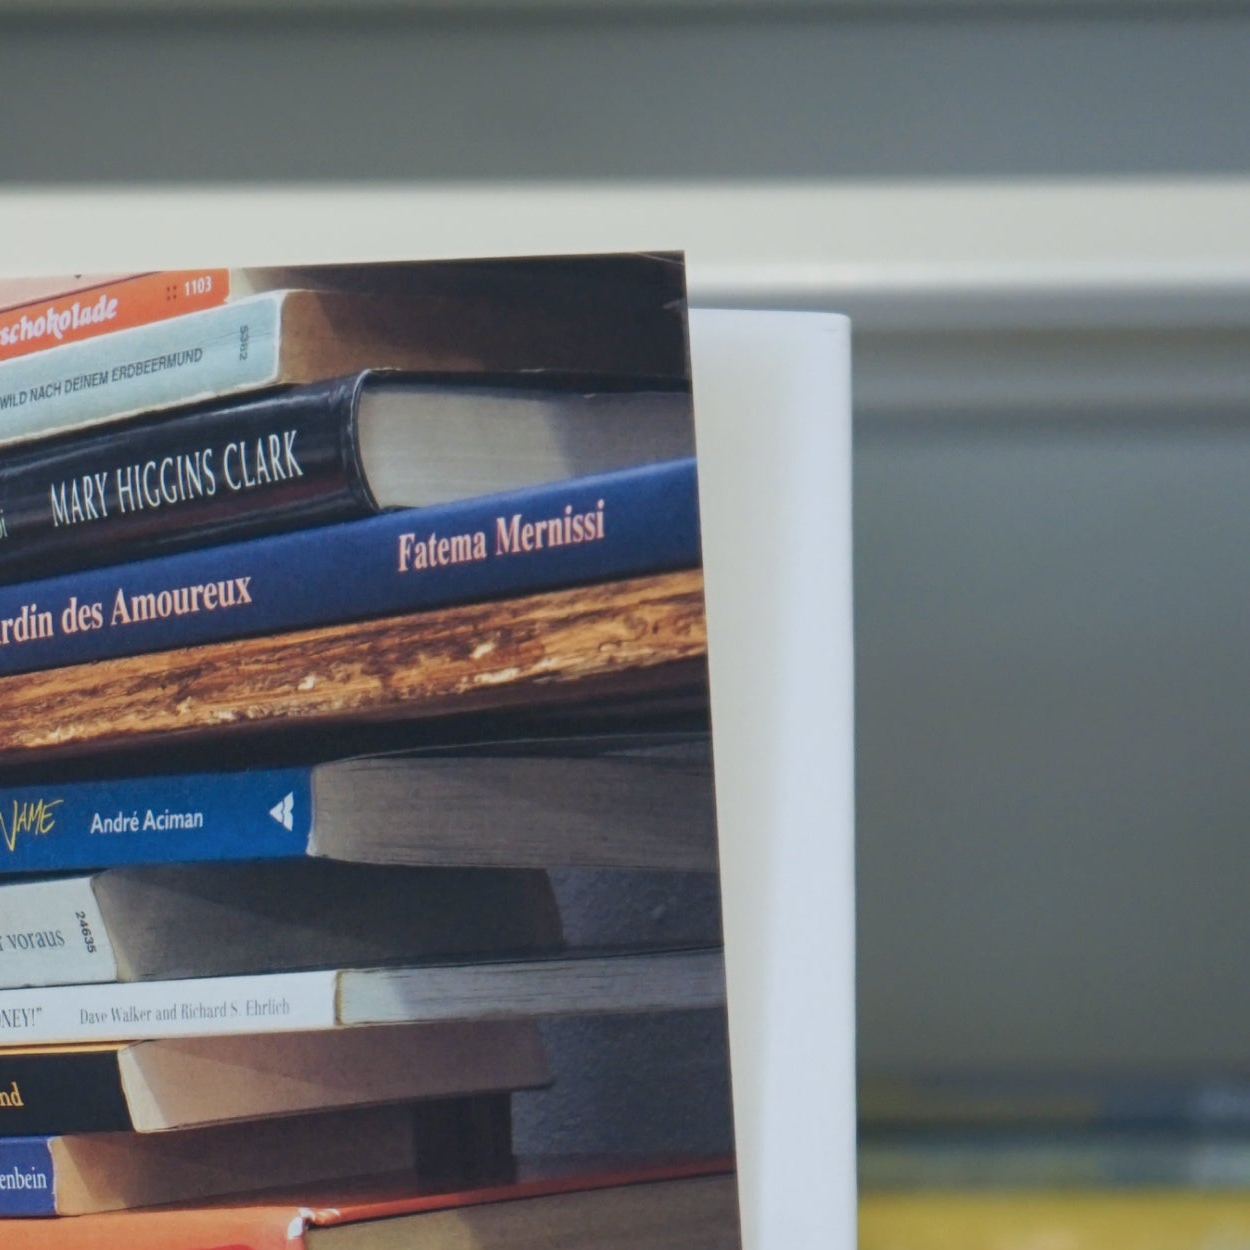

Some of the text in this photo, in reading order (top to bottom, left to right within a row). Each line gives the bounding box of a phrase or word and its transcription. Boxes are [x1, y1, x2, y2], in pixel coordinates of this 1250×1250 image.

[184, 276, 213, 297] 1103
[0, 392, 28, 411] WILD
[29, 383, 62, 402] NACH
[64, 371, 109, 394] DEINEM
[111, 347, 204, 382] ERDBEERMUND
[50, 430, 304, 527] MARY HIGGINS CLARK
[397, 499, 605, 572] Fatema Mernissi
[61, 597, 104, 633] des
[110, 576, 253, 626] Amoureux
[90, 808, 204, 834] André Aciman
[5, 928, 66, 951] voraus
[74, 910, 97, 954] 24635
[79, 997, 291, 1026] Dave Walker and Richard S. Ehrlich
